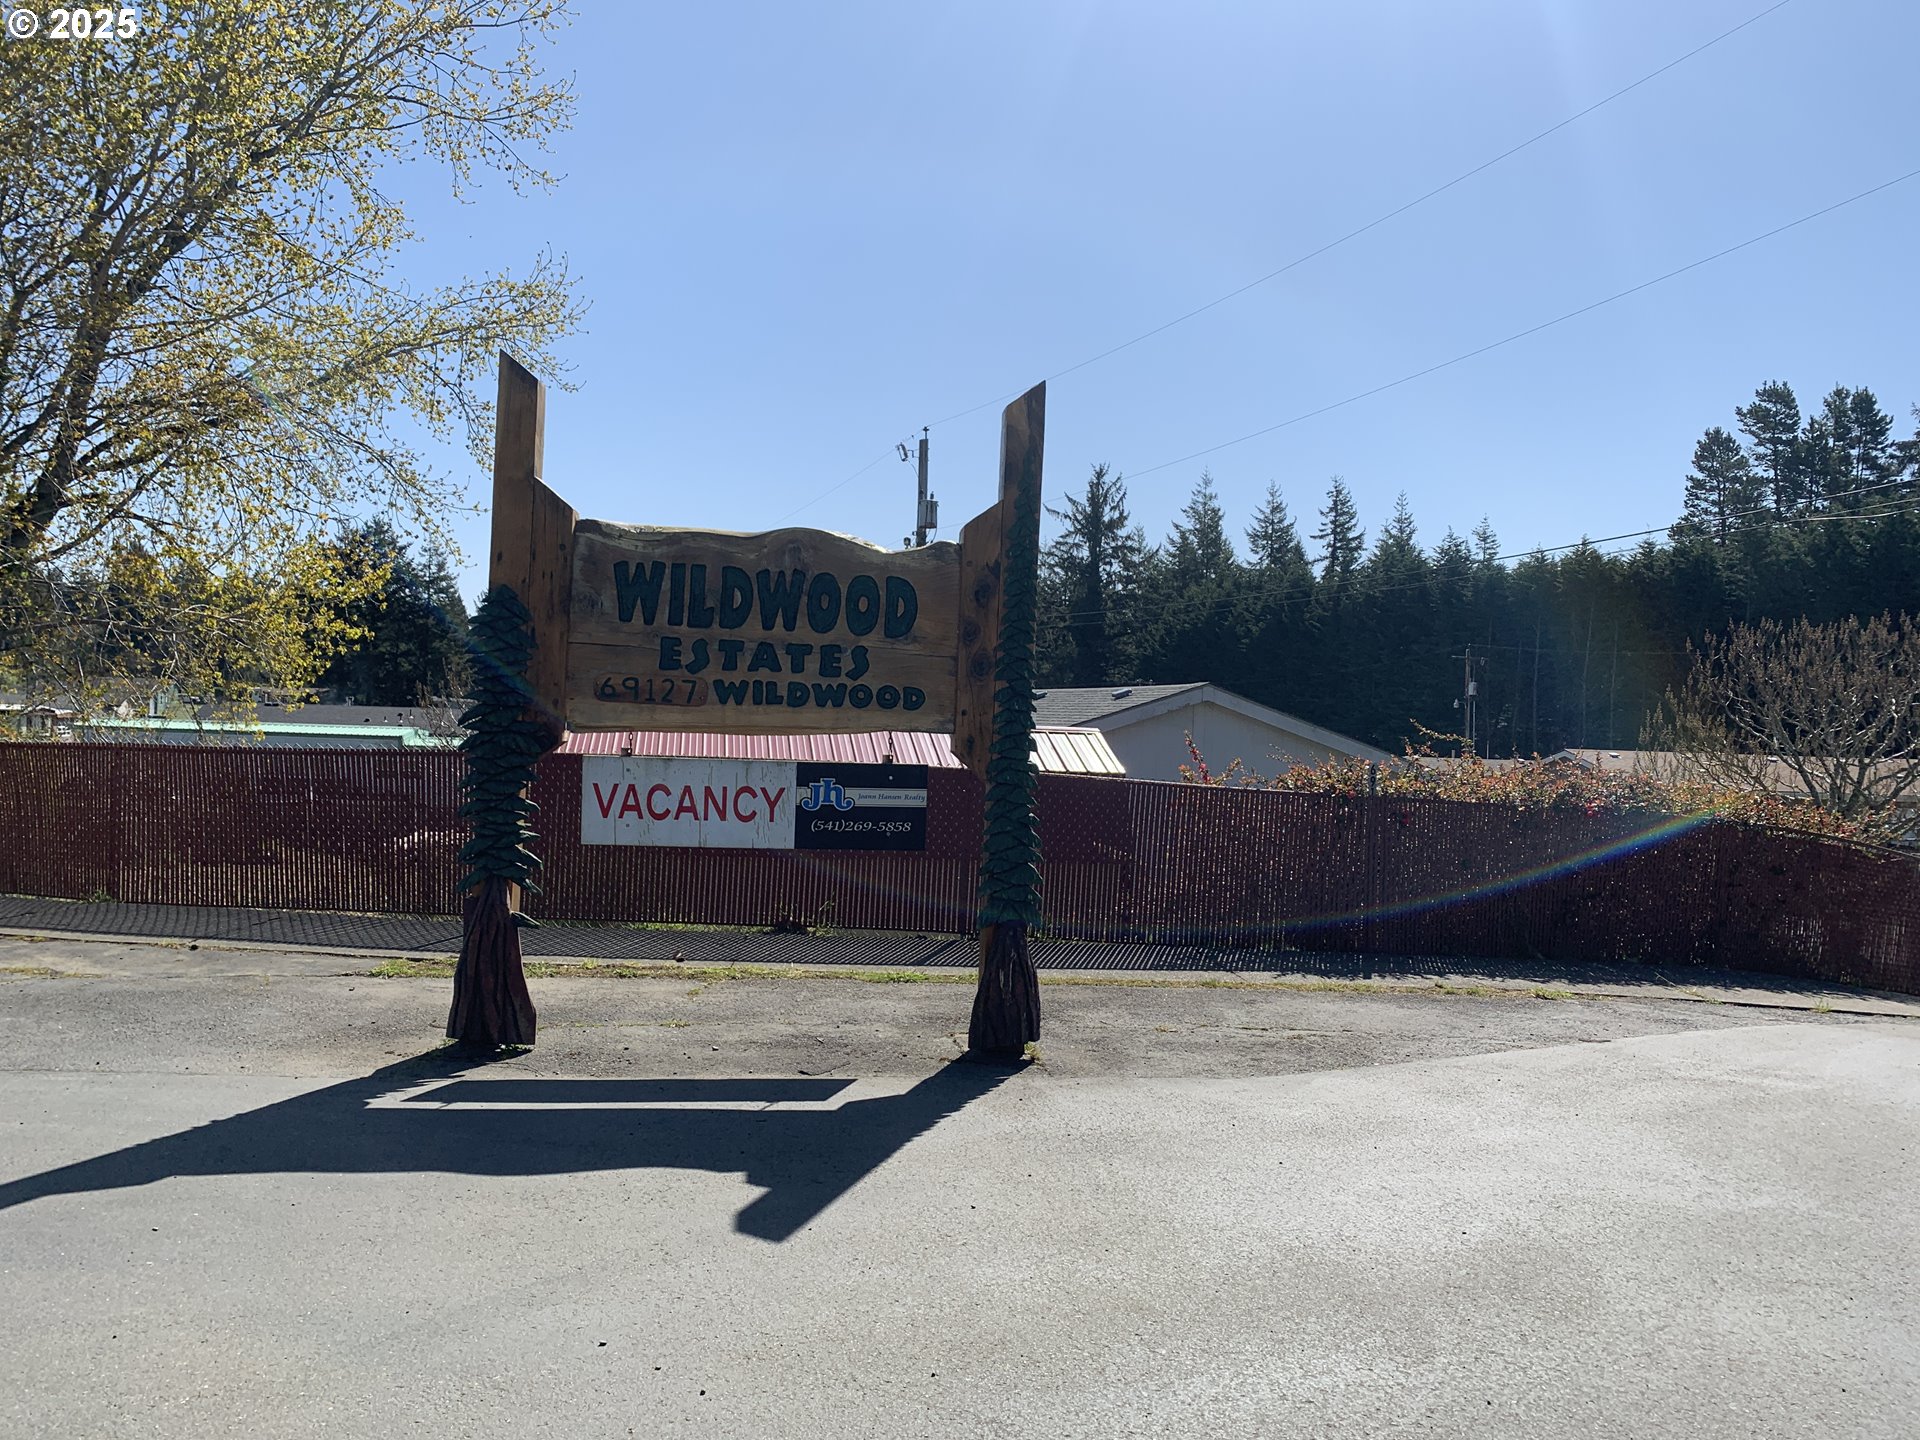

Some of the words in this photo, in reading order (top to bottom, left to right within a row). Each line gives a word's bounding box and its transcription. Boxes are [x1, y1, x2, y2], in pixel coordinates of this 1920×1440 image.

[613, 560, 918, 638] WILDWOOD
[658, 636, 870, 681] ESTATES
[600, 676, 698, 704] 69127
[713, 679, 926, 711] WILDWOOD
[592, 782, 786, 823] VACANCY
[904, 794, 925, 802] Realty
[811, 820, 911, 832] (541)269-5858
